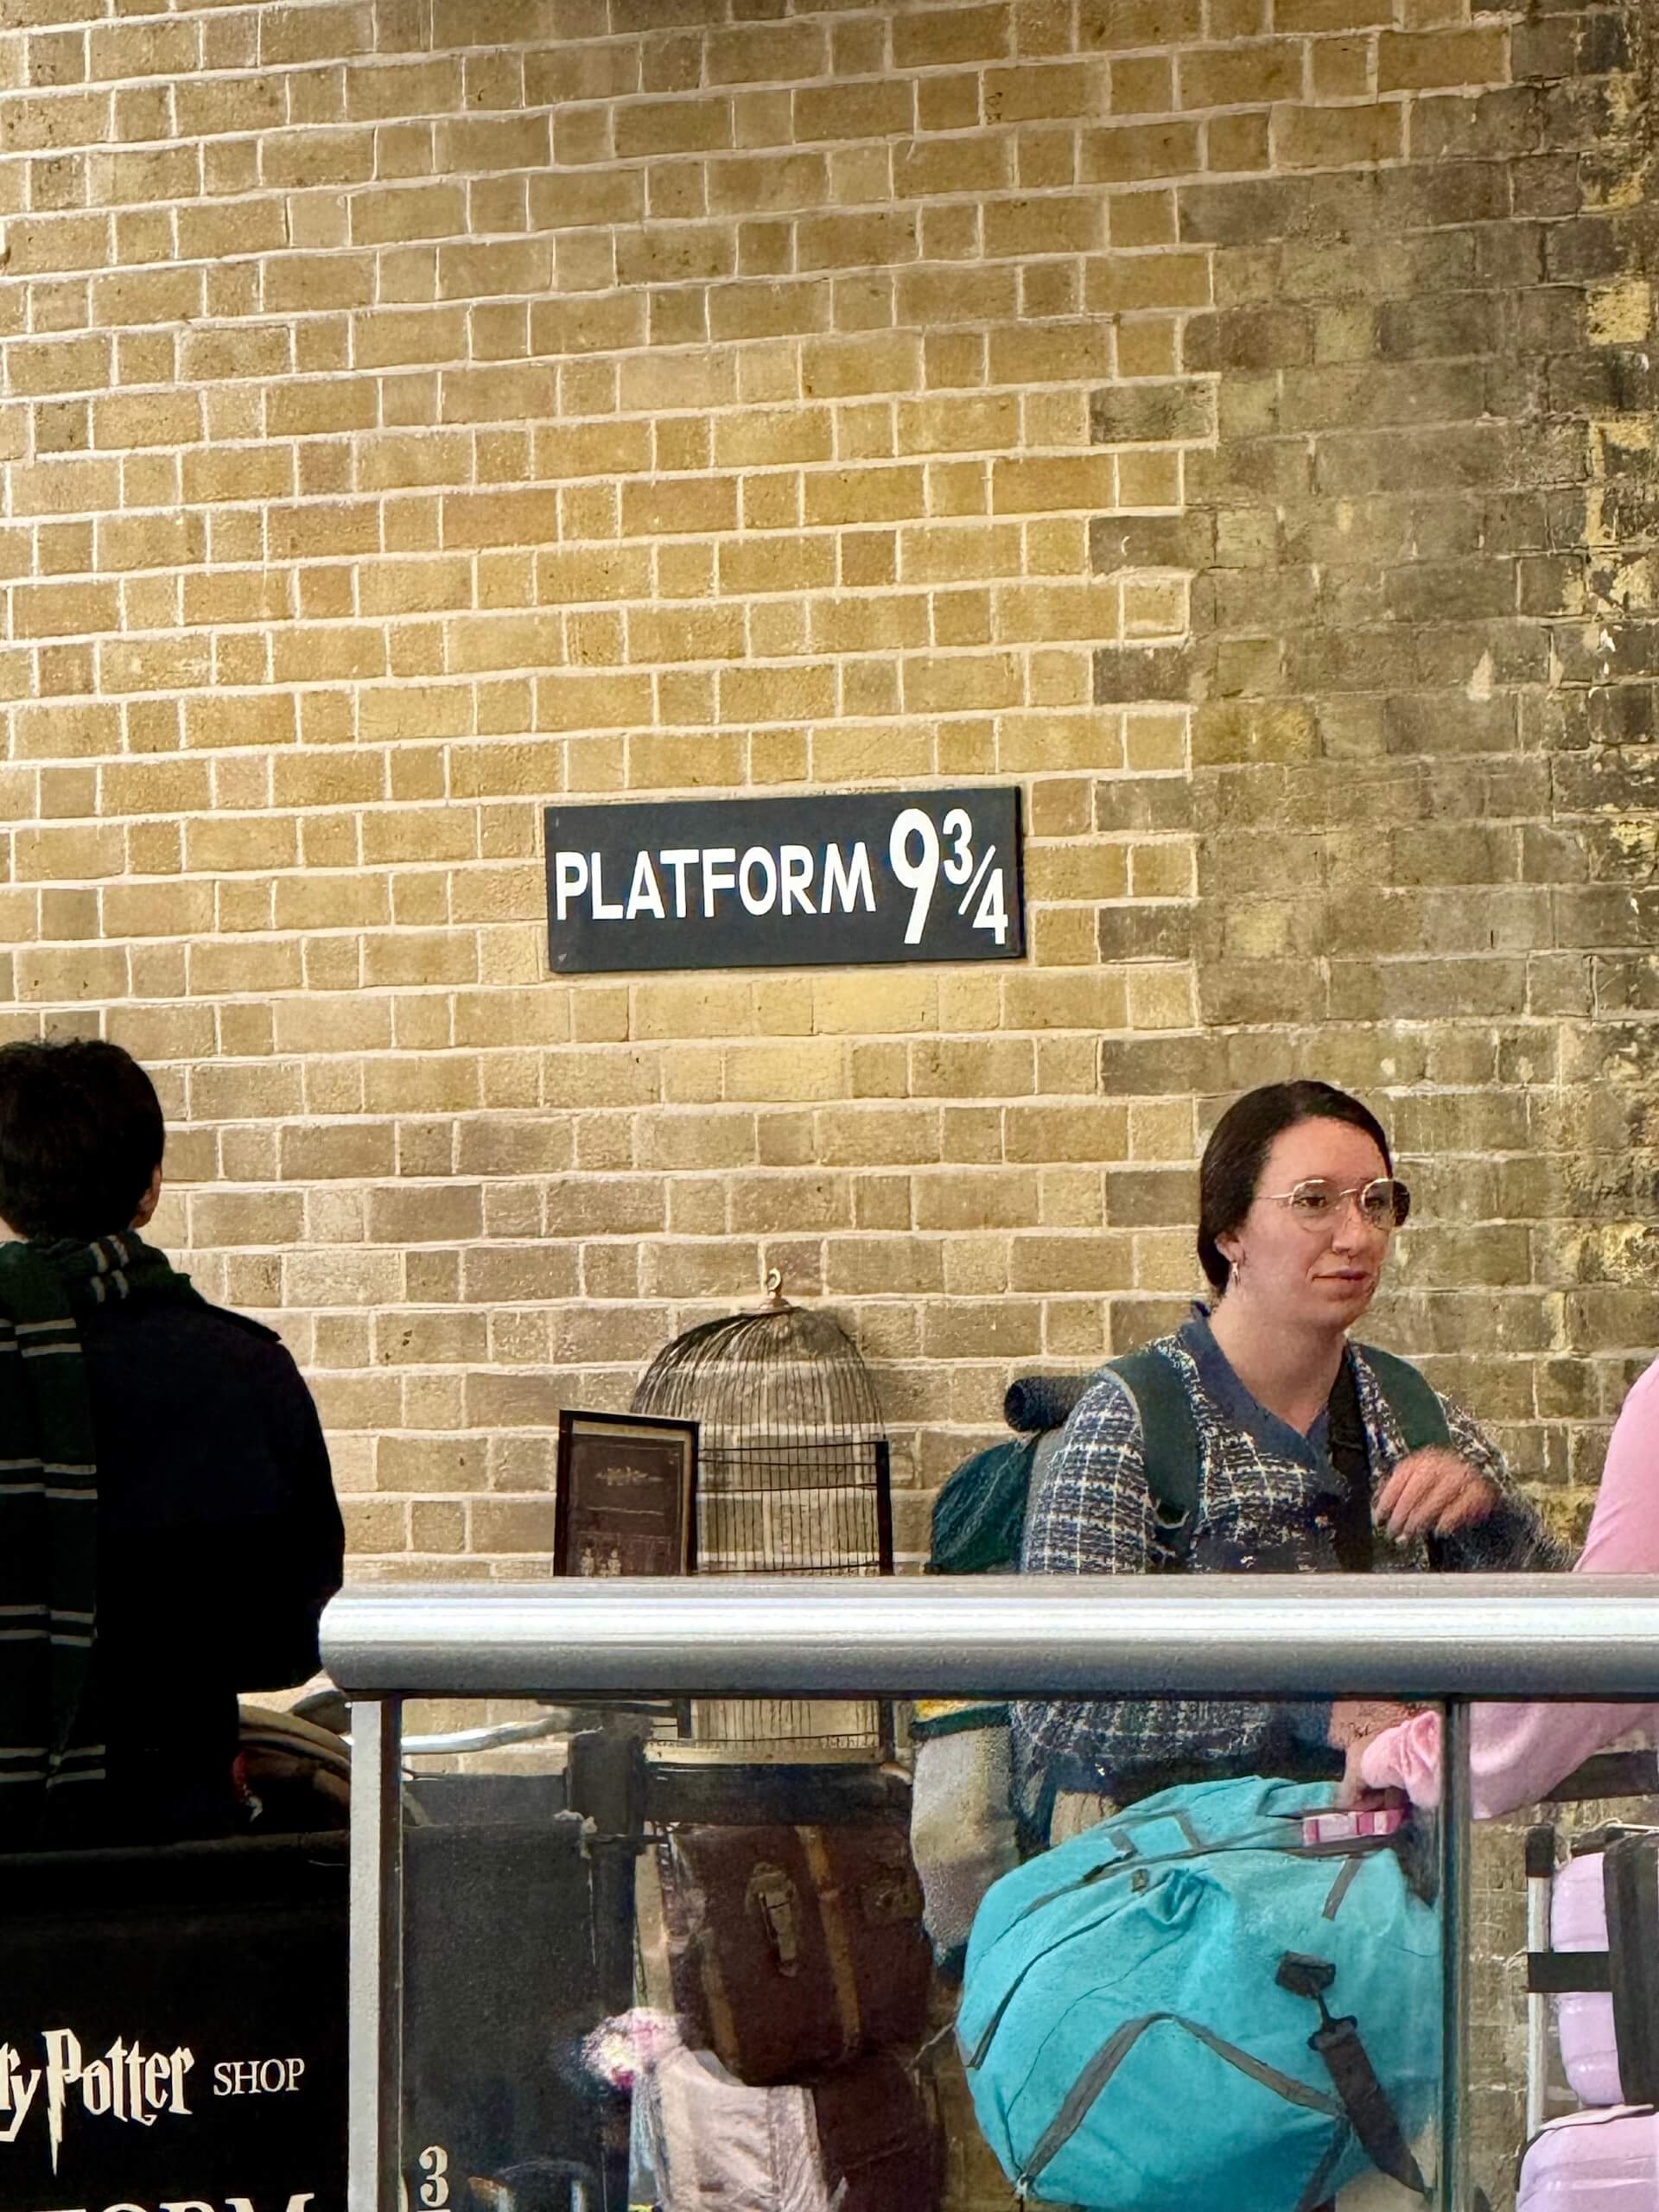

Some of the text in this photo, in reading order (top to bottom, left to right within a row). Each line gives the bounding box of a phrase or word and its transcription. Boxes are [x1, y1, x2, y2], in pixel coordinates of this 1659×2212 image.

[555, 841, 877, 921] PLATFORM
[41, 2028, 195, 2177] Potter
[213, 2057, 305, 2097] SHOP
